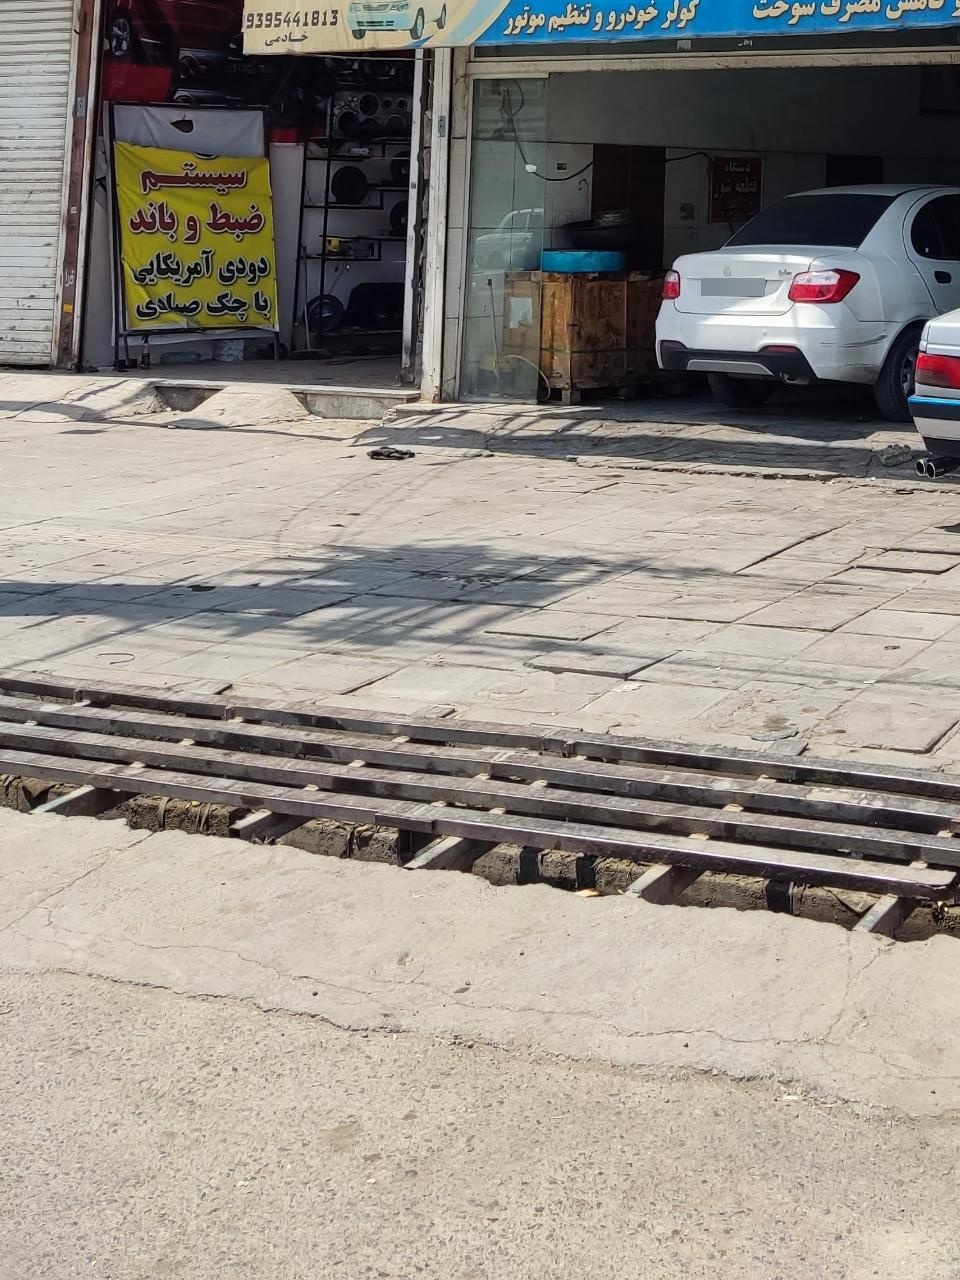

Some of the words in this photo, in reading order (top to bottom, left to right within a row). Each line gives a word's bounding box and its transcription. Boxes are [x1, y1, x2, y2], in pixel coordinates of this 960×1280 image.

[246, 9, 339, 29] 9395441813
[503, 6, 546, 36] موتور
[548, 3, 593, 32] تنظیم
[592, 10, 603, 32] و
[605, 0, 659, 32] خودرو
[264, 31, 308, 47] خادمی
[140, 162, 248, 194] سیستم
[129, 201, 177, 242] باند
[183, 213, 201, 244] و
[206, 203, 266, 241] ضبط
[218, 255, 270, 285] دودی
[136, 291, 202, 319] صیادی
[206, 290, 249, 321] چک
[253, 291, 272, 318] با
